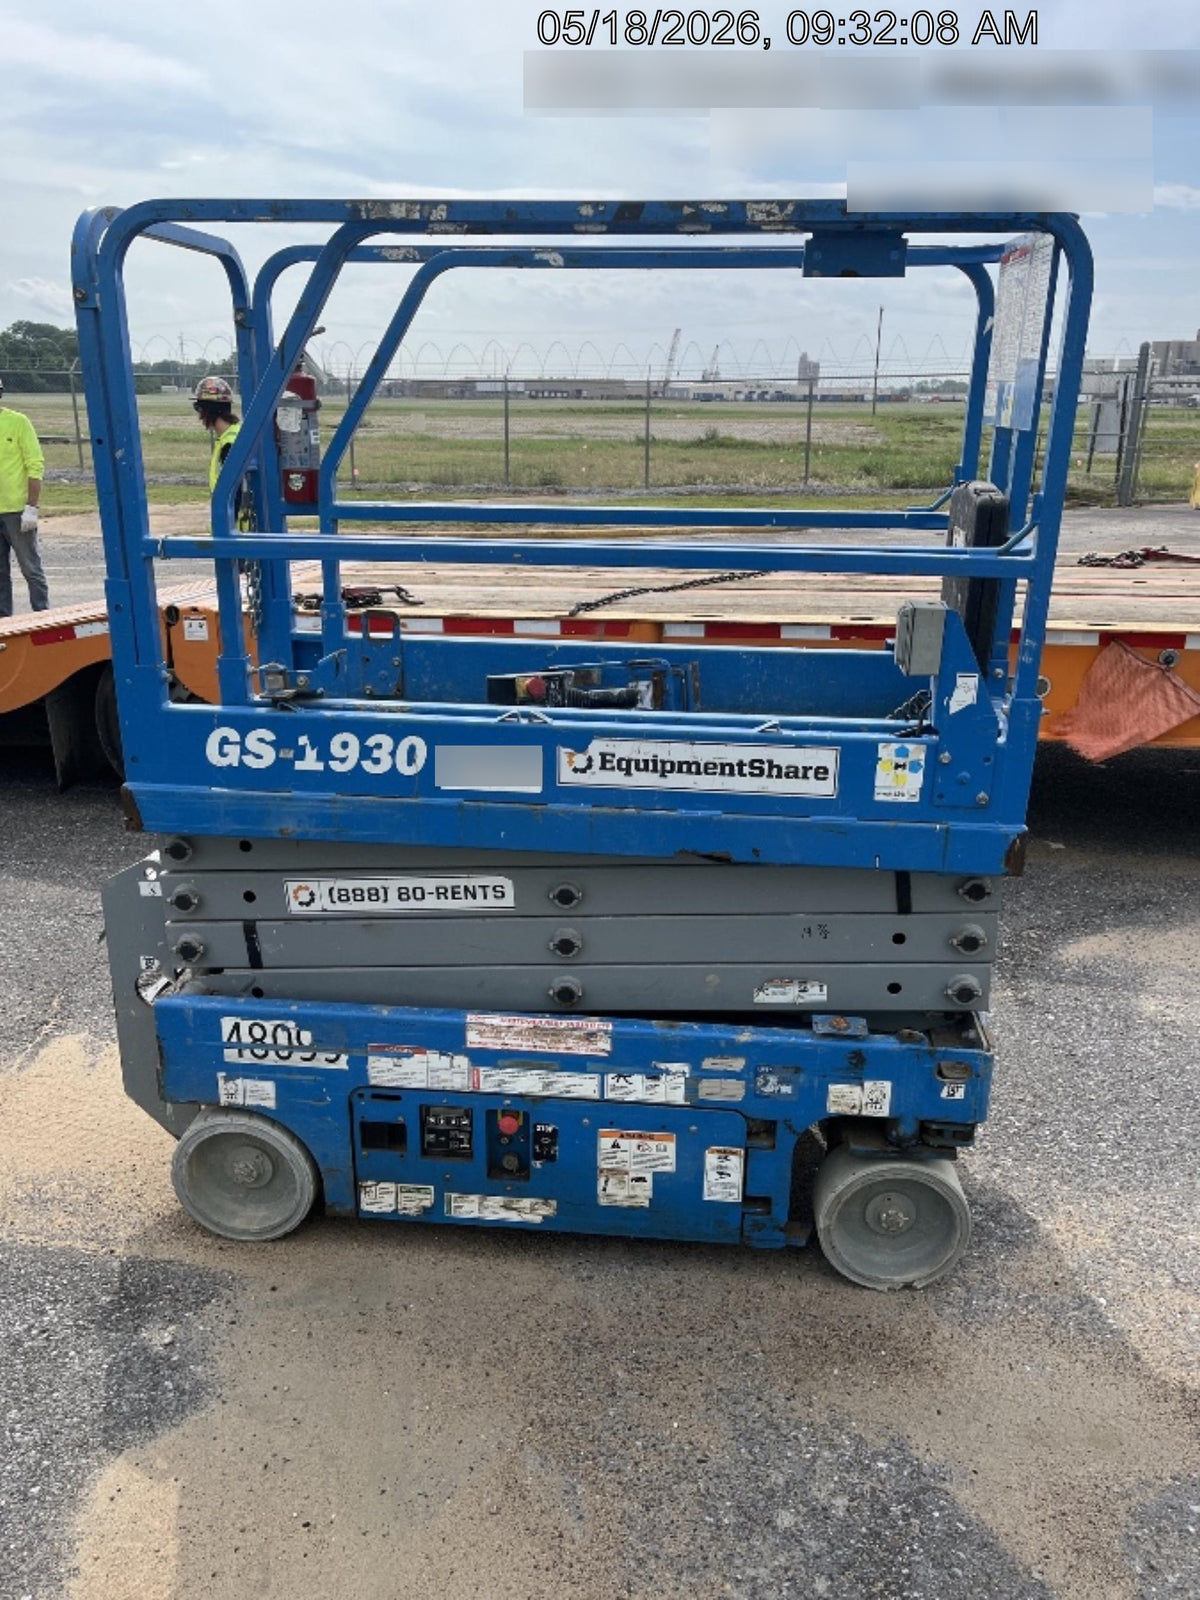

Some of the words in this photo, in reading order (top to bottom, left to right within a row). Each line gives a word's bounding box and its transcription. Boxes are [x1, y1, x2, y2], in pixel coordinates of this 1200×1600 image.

[205, 726, 428, 776] GS-1930
[598, 751, 829, 782] EquipmentShare
[328, 886, 389, 904] (888)
[397, 884, 506, 902] 80-RENTS
[223, 1021, 343, 1064] 480
